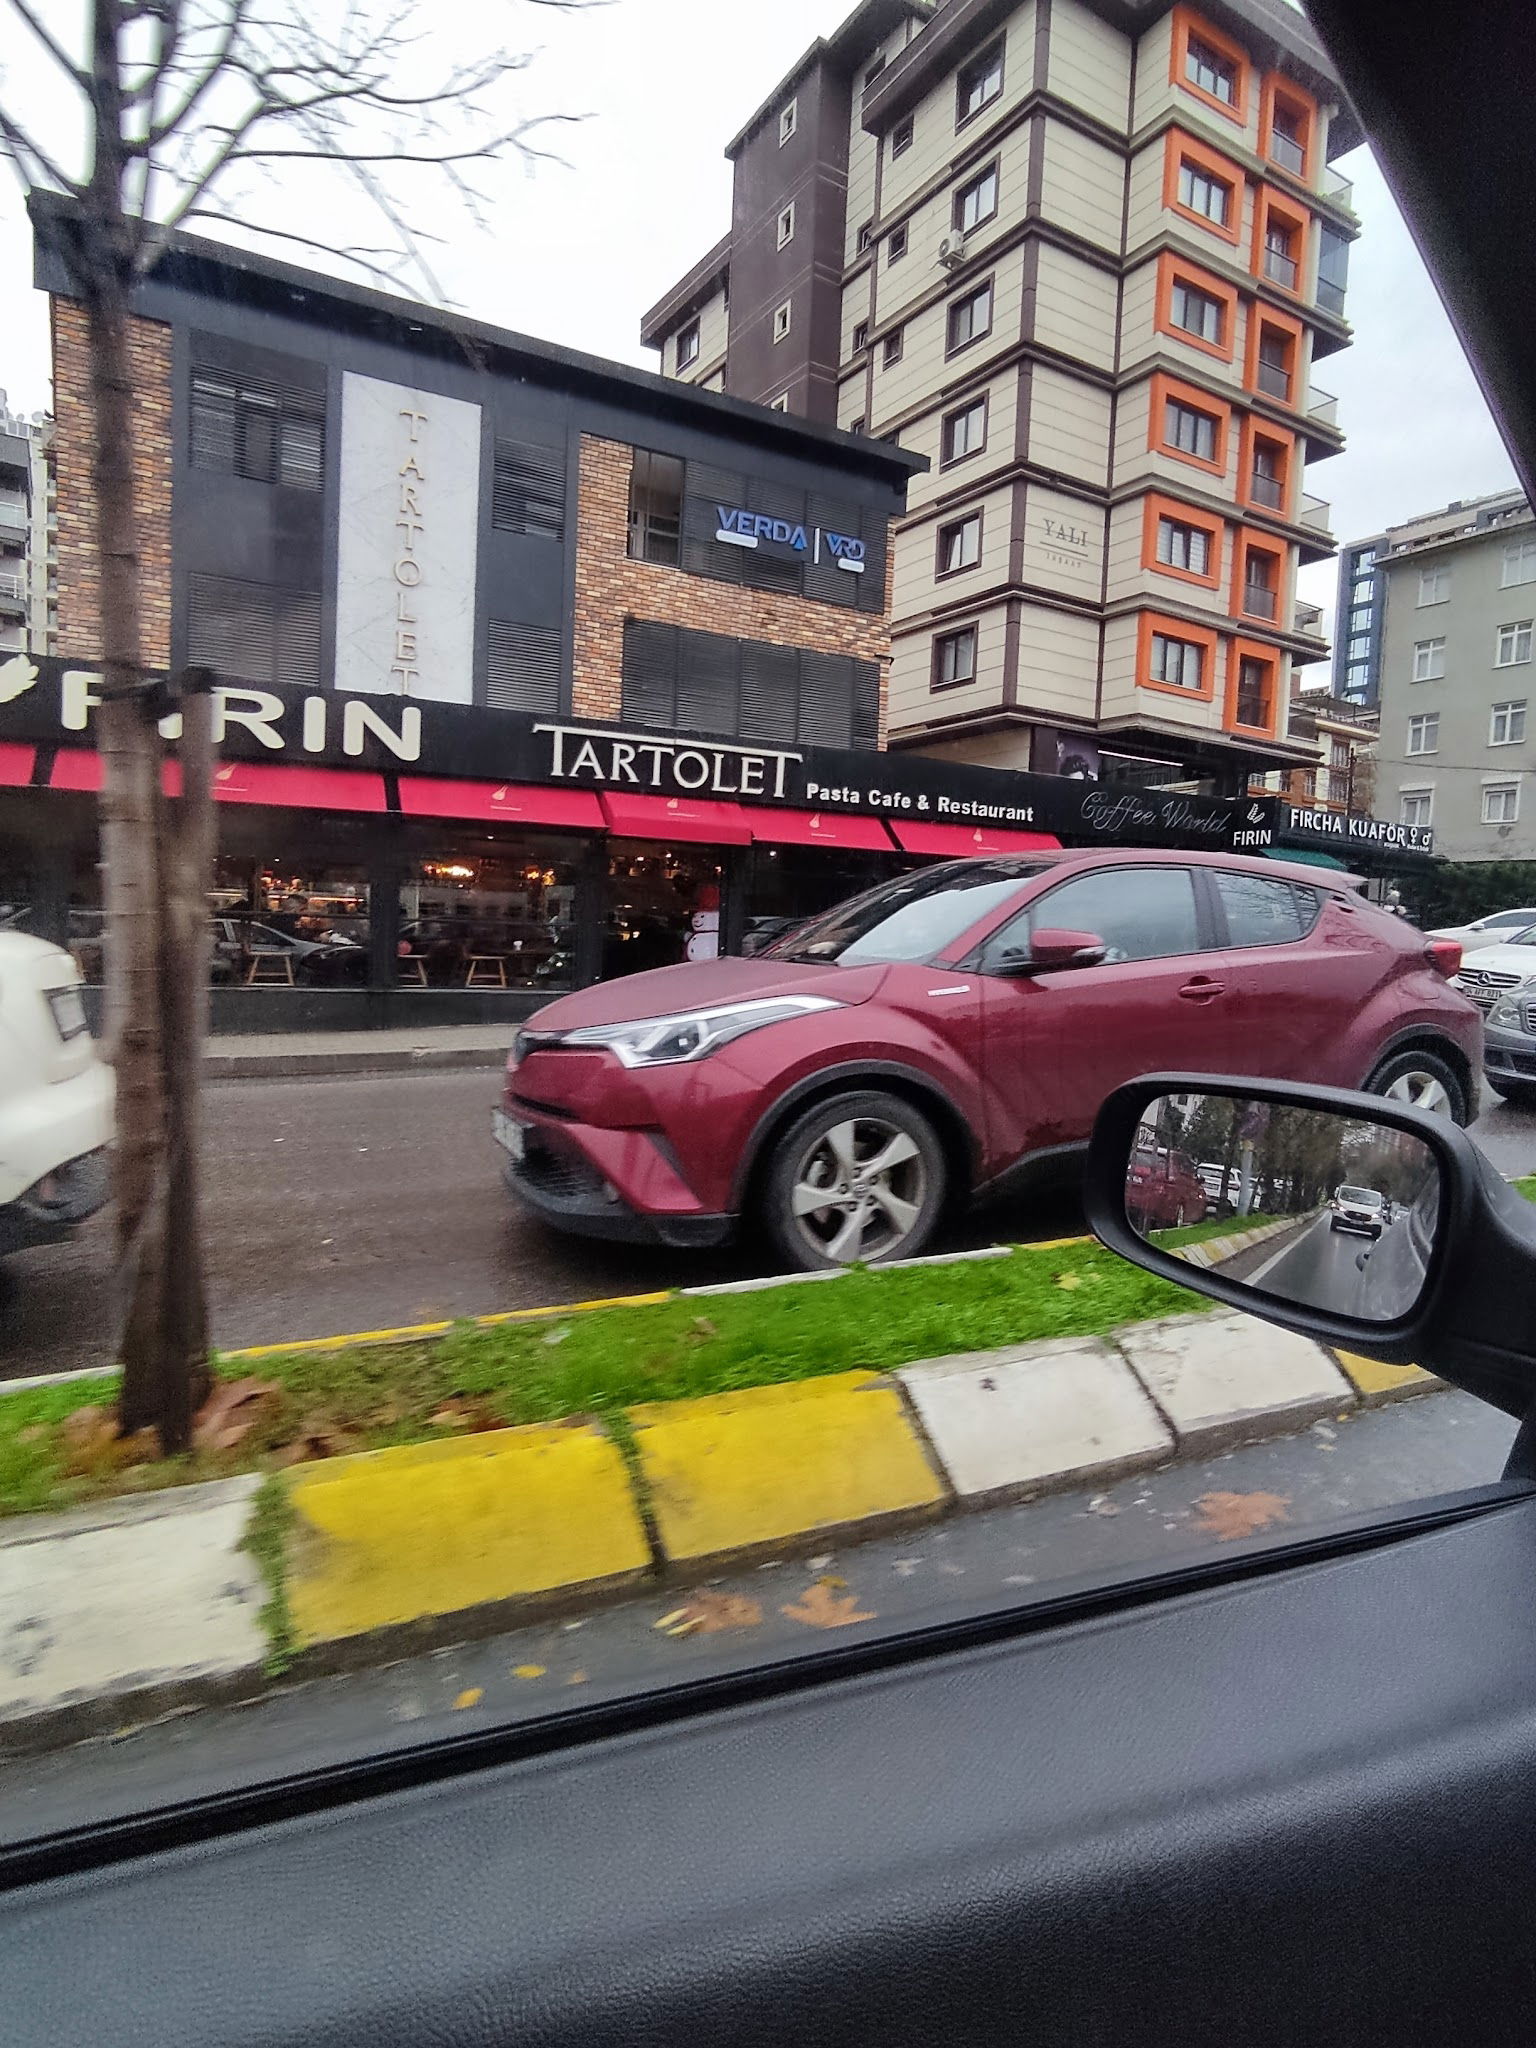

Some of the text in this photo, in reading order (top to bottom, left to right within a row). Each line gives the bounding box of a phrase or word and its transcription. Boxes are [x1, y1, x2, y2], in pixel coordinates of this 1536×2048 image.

[717, 505, 808, 550] VERDA
[1043, 518, 1088, 548] YALI
[392, 409, 428, 695] TARTOLET
[532, 723, 803, 798] TARTOLET
[806, 782, 1034, 822] Pasta Cafe & Restaurant
[1080, 791, 1232, 833] Coffee World
[1233, 829, 1272, 846] FIRIN
[1290, 808, 1406, 847] FIRCHA KUAFÖR
